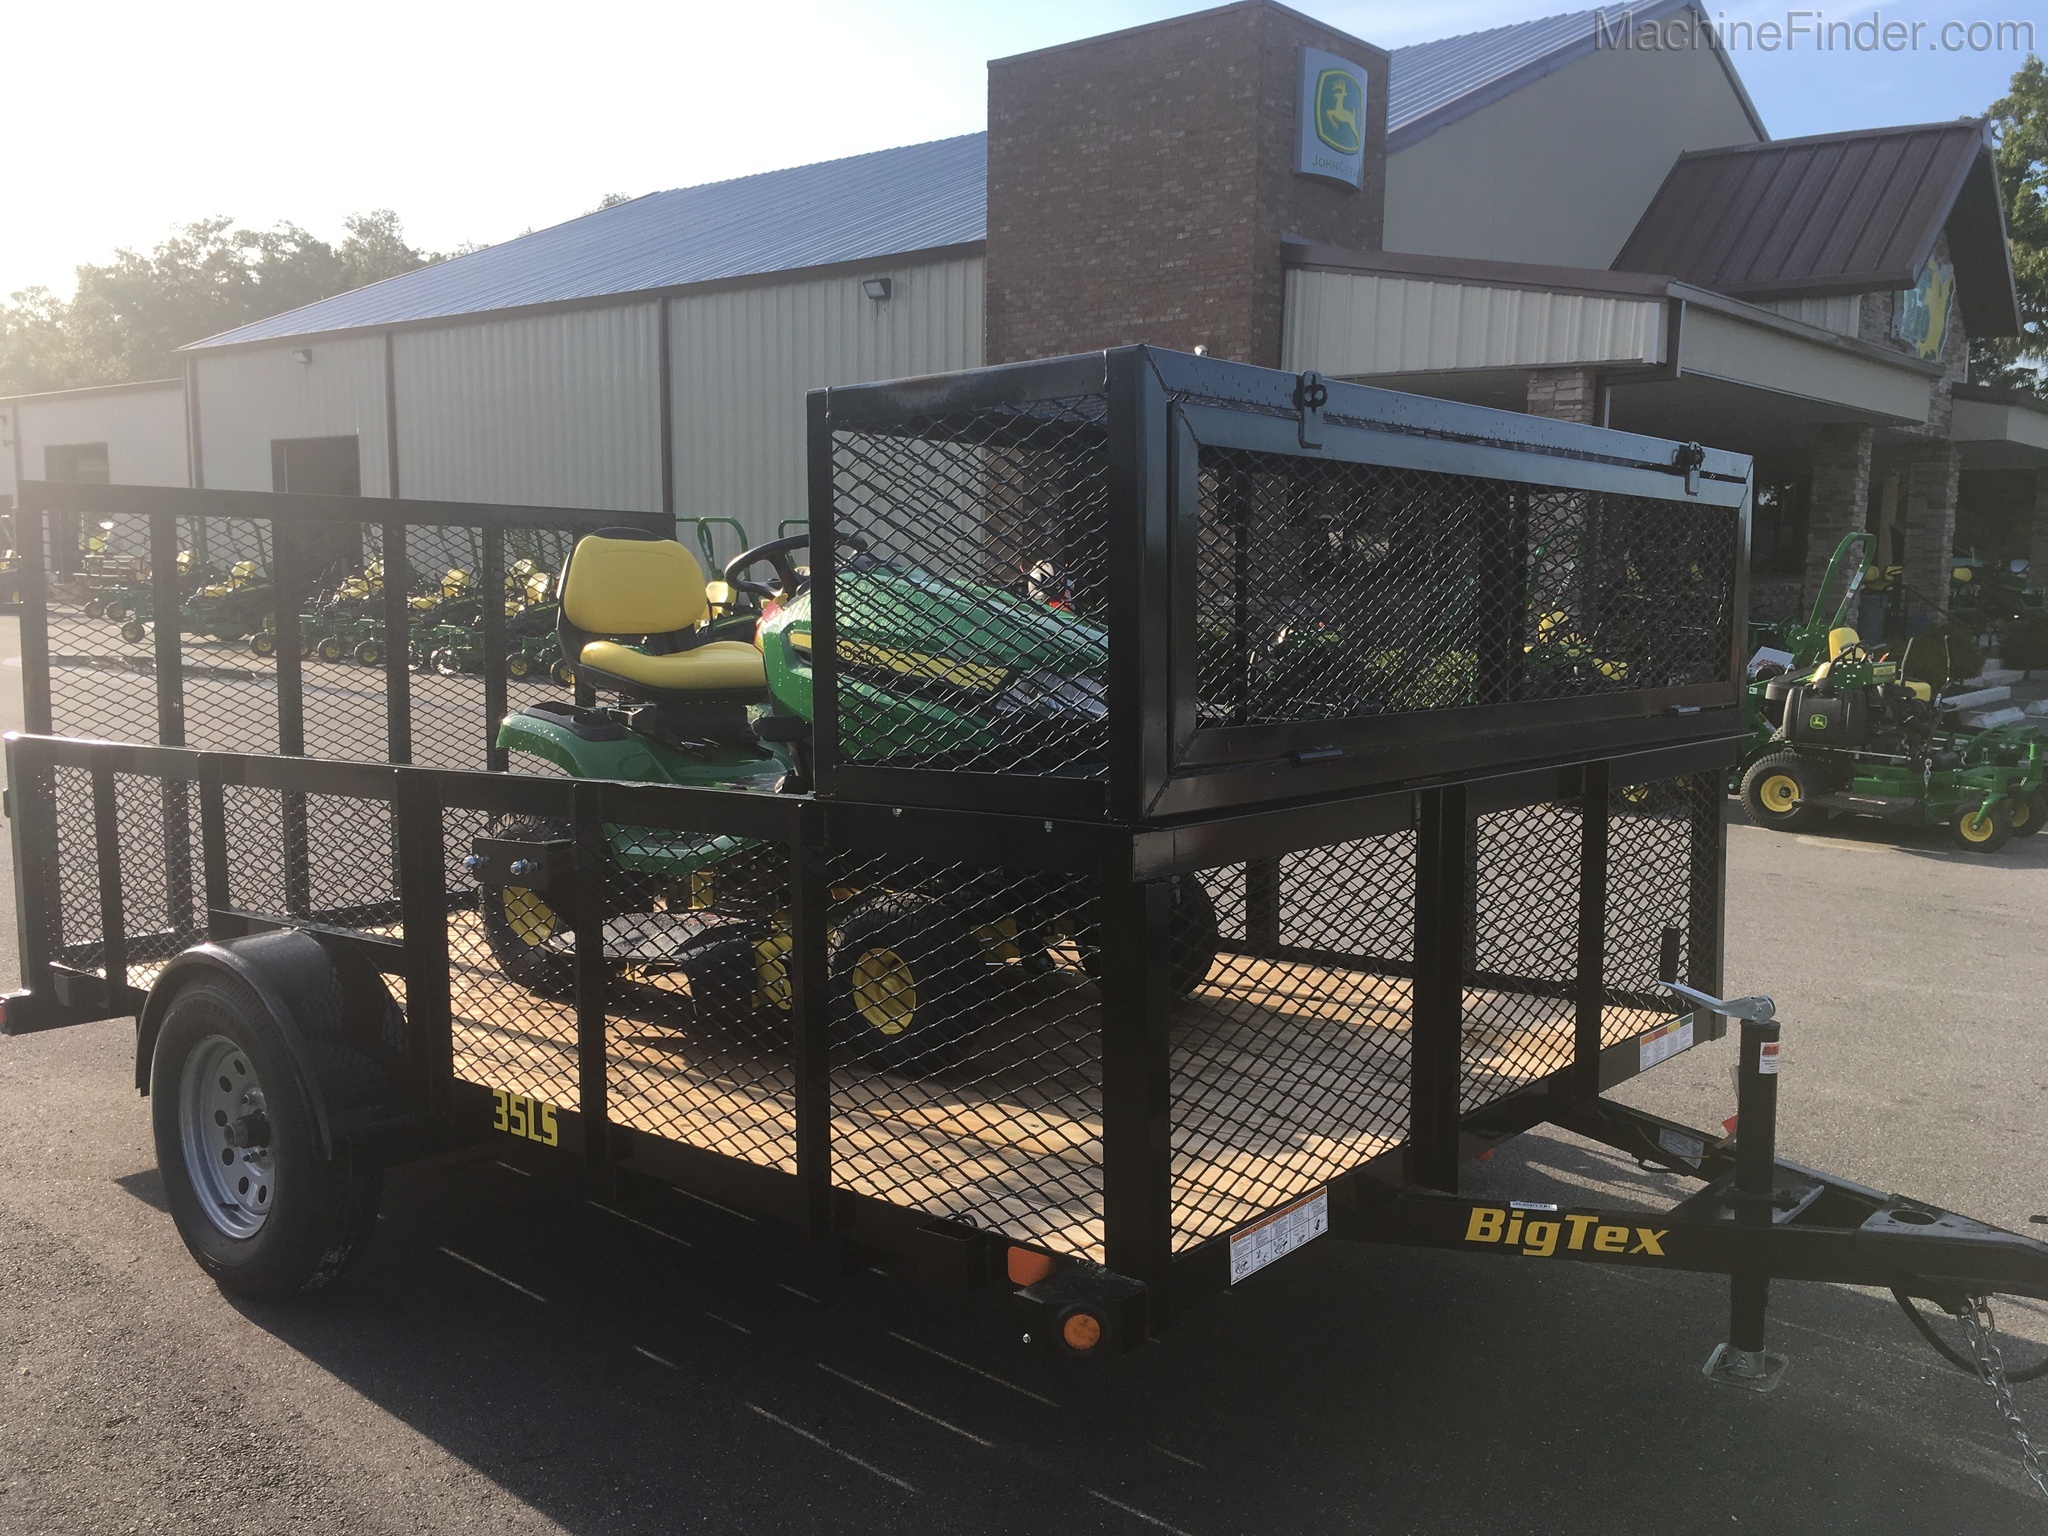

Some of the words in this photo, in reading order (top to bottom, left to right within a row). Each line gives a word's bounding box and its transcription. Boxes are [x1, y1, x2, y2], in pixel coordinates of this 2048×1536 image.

[1311, 154, 1339, 171] JOHN
[492, 1087, 558, 1147] 35LS
[1464, 1206, 1670, 1257] BigTex
